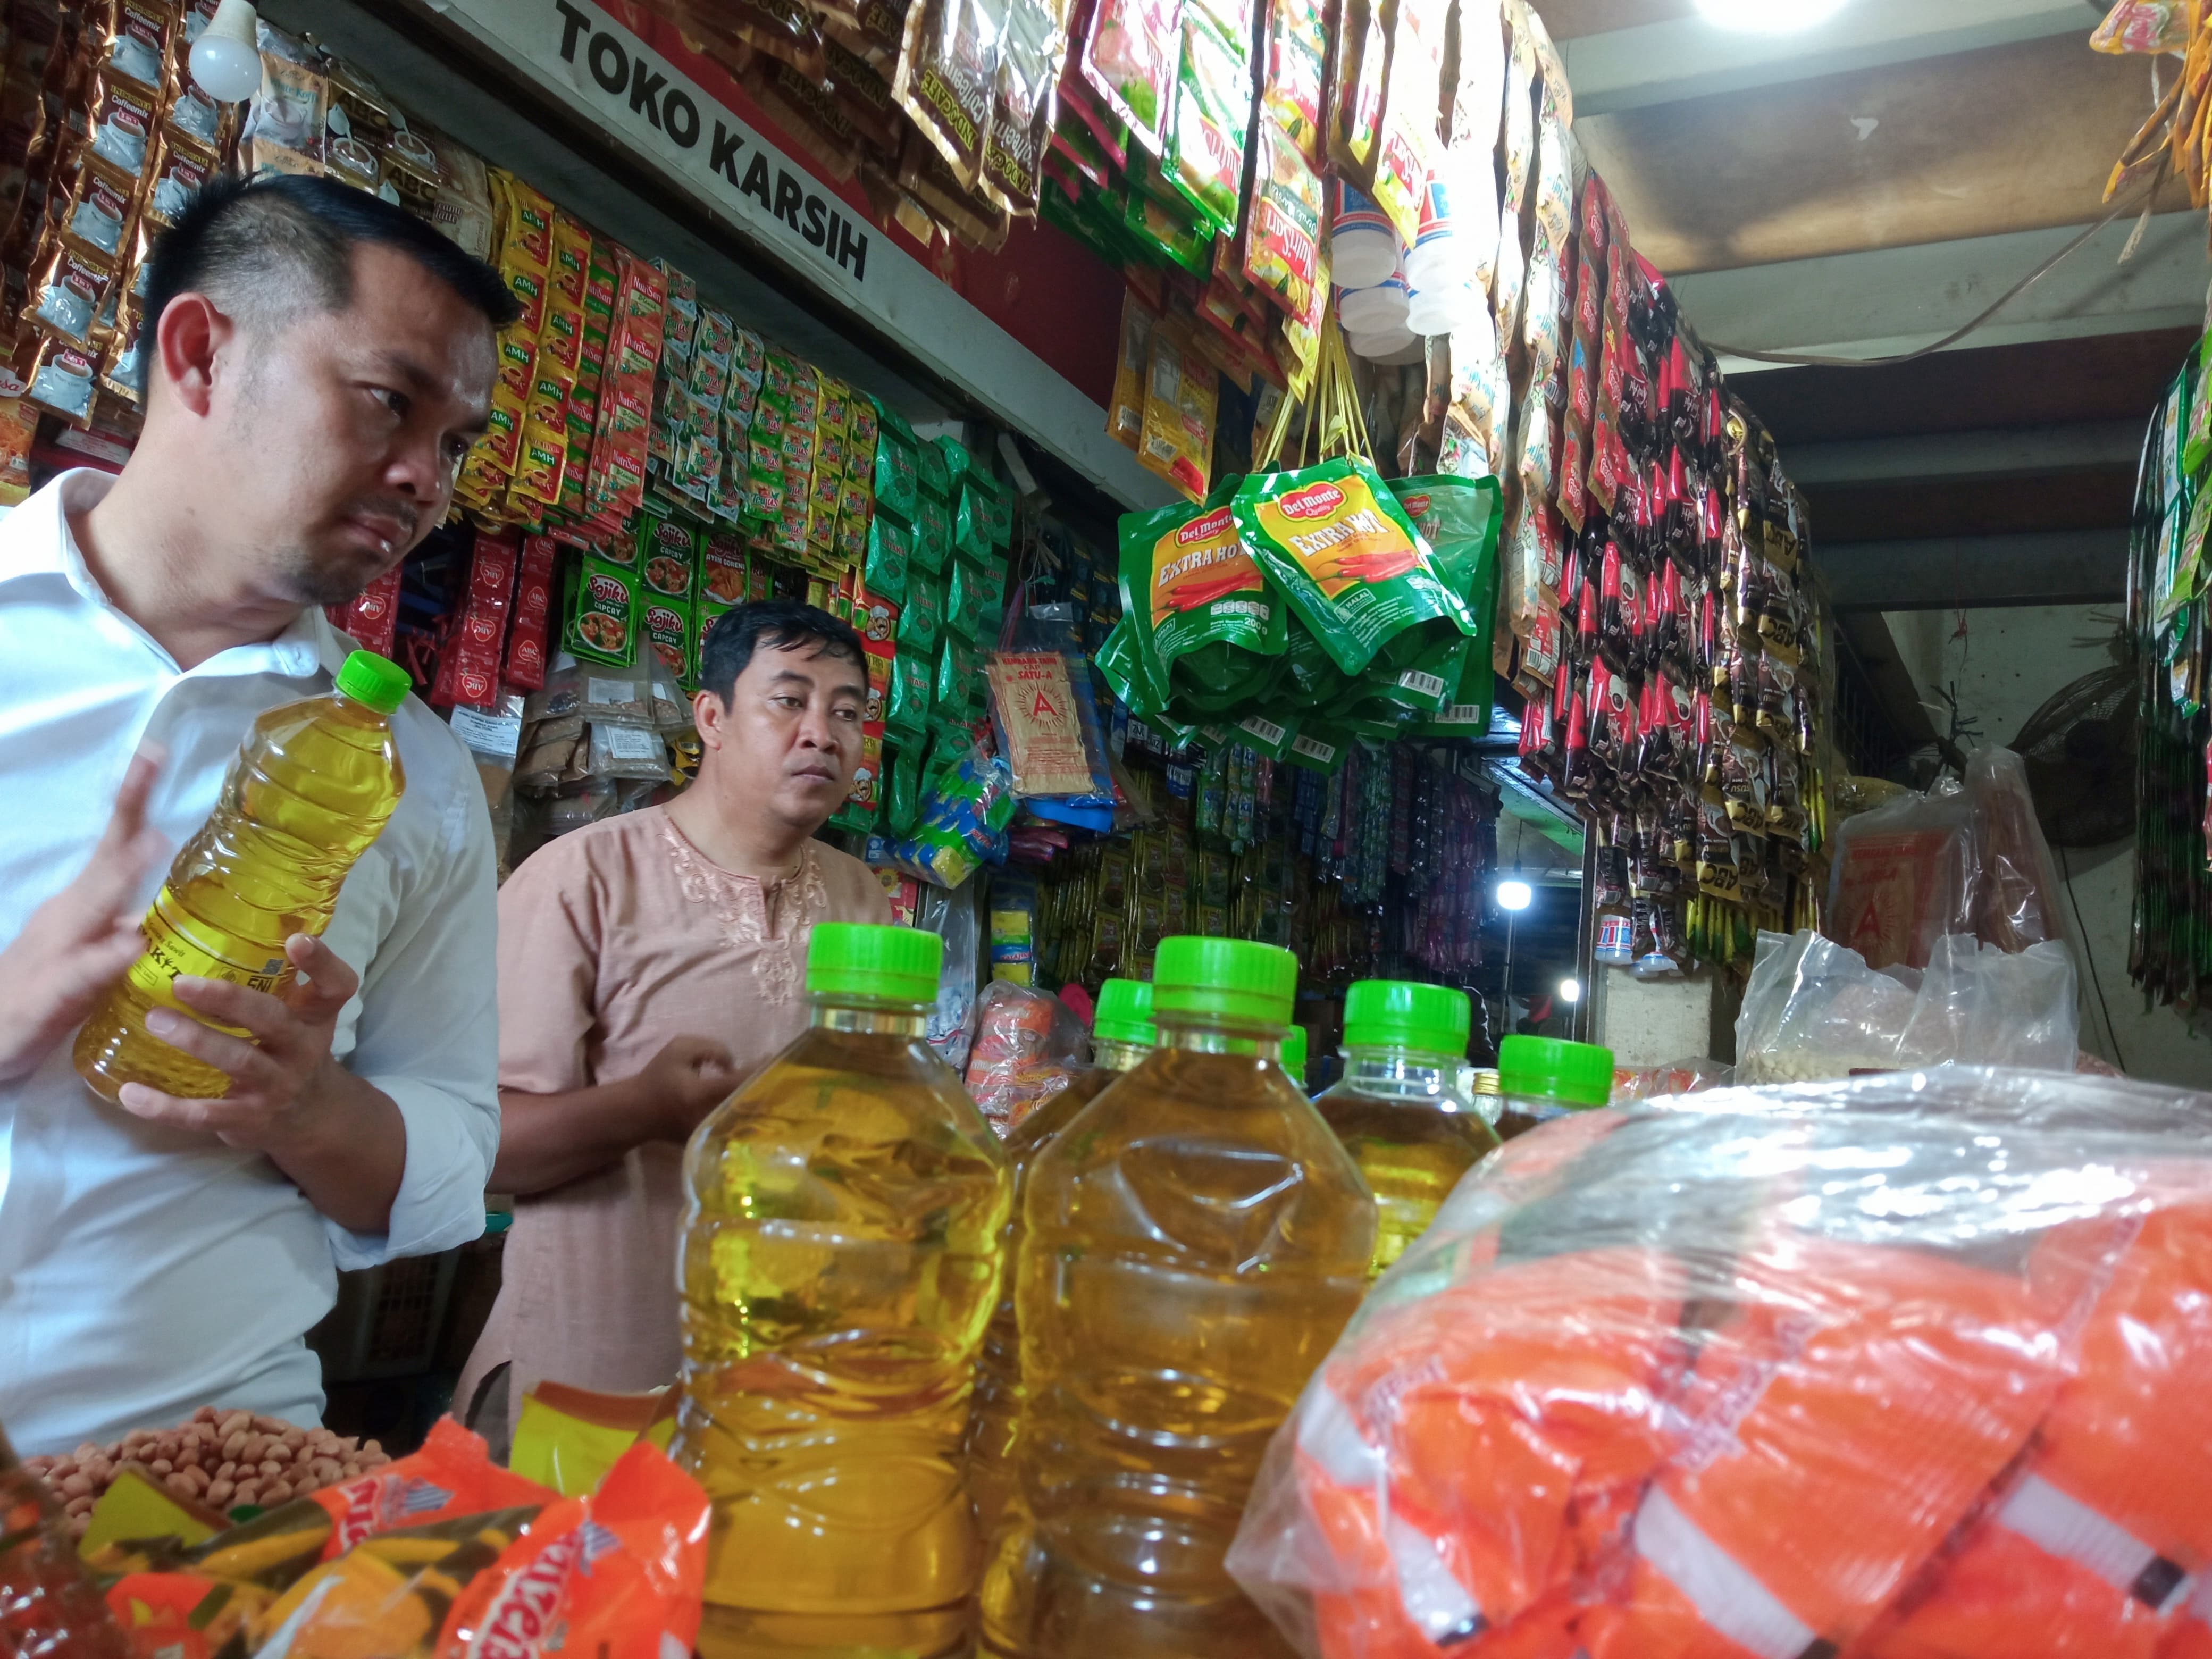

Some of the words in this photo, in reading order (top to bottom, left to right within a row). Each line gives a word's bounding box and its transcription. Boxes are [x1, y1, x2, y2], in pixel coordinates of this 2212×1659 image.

[112, 95, 148, 119] Coffeemix
[556, 3, 700, 148] TOKO
[710, 120, 868, 282] KARSIH
[173, 150, 205, 174] Coffeemix
[94, 177, 127, 204] Coffeemix
[387, 166, 438, 200] ABC
[1266, 209, 1314, 282] NutriSari
[588, 281, 612, 305] utriSari
[633, 275, 662, 303] NutriSari
[626, 332, 654, 359] NutriSari
[618, 391, 645, 417] NutriSari
[613, 449, 640, 475] NutriSari
[1282, 500, 1302, 516] Del
[1303, 489, 1341, 507] Monte
[1305, 503, 1332, 516] Quality
[655, 522, 691, 547] Sajiku
[1180, 526, 1199, 542] Del
[1288, 521, 1354, 557] EXTRA
[1345, 508, 1390, 534] HOT
[660, 546, 683, 559] CAPCAY
[706, 553, 722, 564] AYAM
[1158, 548, 1213, 588] EXTRA
[588, 574, 629, 604] Sajiku
[1346, 592, 1370, 608] HALAL
[594, 601, 621, 616] CAPCAY
[645, 608, 684, 633] Sajiku
[1244, 617, 1261, 631] 200
[653, 632, 677, 644] CAPCAY
[1018, 671, 1052, 680] SATU-A
[1033, 690, 1058, 717] A
[1736, 801, 1764, 830] ABC
[1702, 862, 1739, 892] ABC
[165, 941, 186, 957] Sawit
